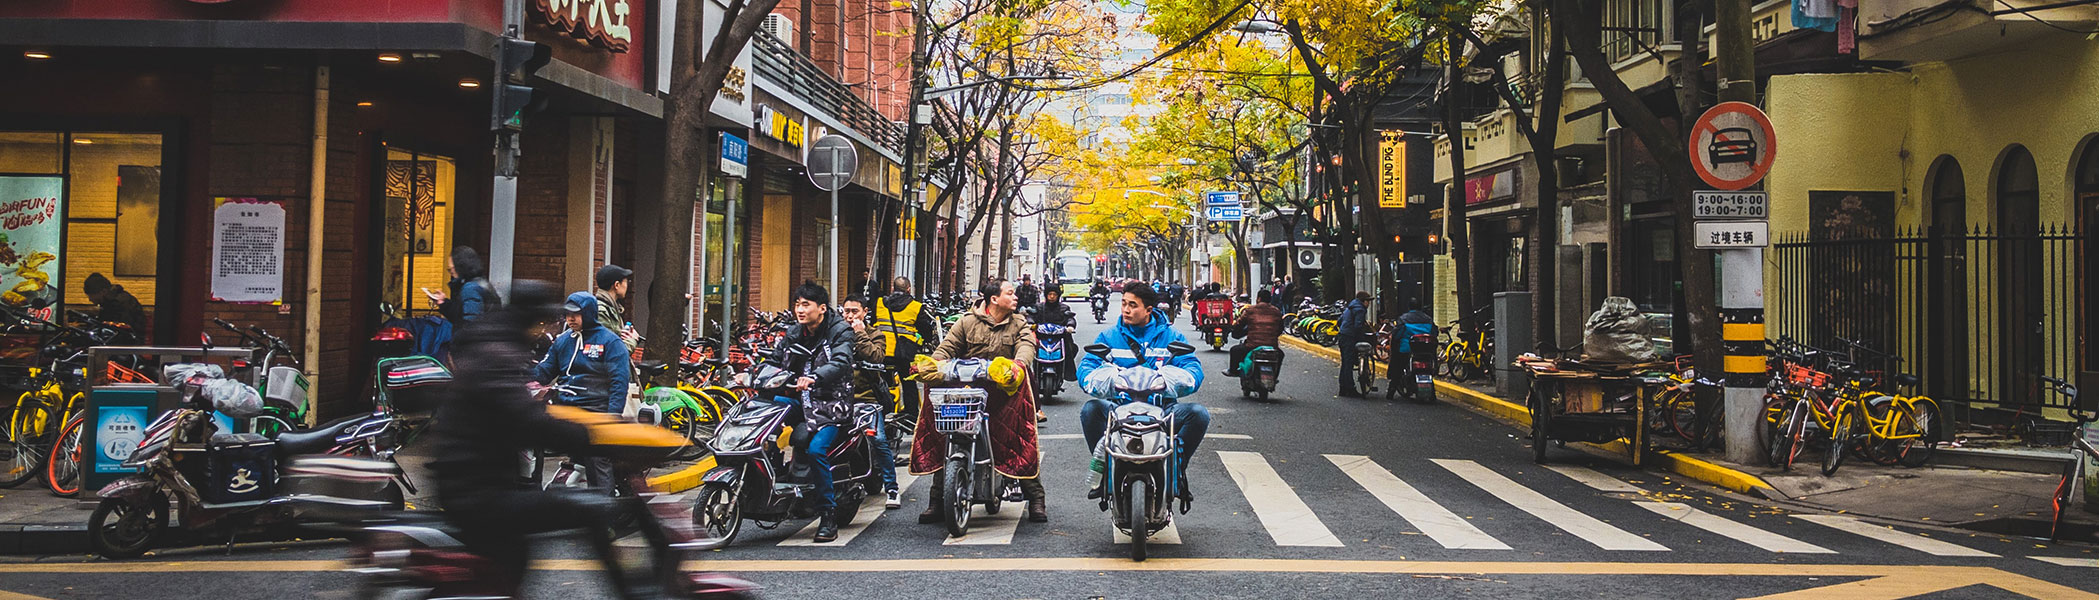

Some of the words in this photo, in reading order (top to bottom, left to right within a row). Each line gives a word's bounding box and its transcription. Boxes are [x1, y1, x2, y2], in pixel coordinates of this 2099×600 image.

[549, 0, 632, 44] 大王
[760, 105, 787, 143] SUBWAY
[1383, 146, 1394, 161] PIG
[1383, 163, 1394, 186] BLIND
[1383, 187, 1394, 202] THE
[1697, 195, 1763, 205] 9:00~16:00
[1213, 207, 1222, 218] P
[1697, 205, 1763, 215] 19:00~7:00
[1710, 231, 1754, 245] 过境车辆
